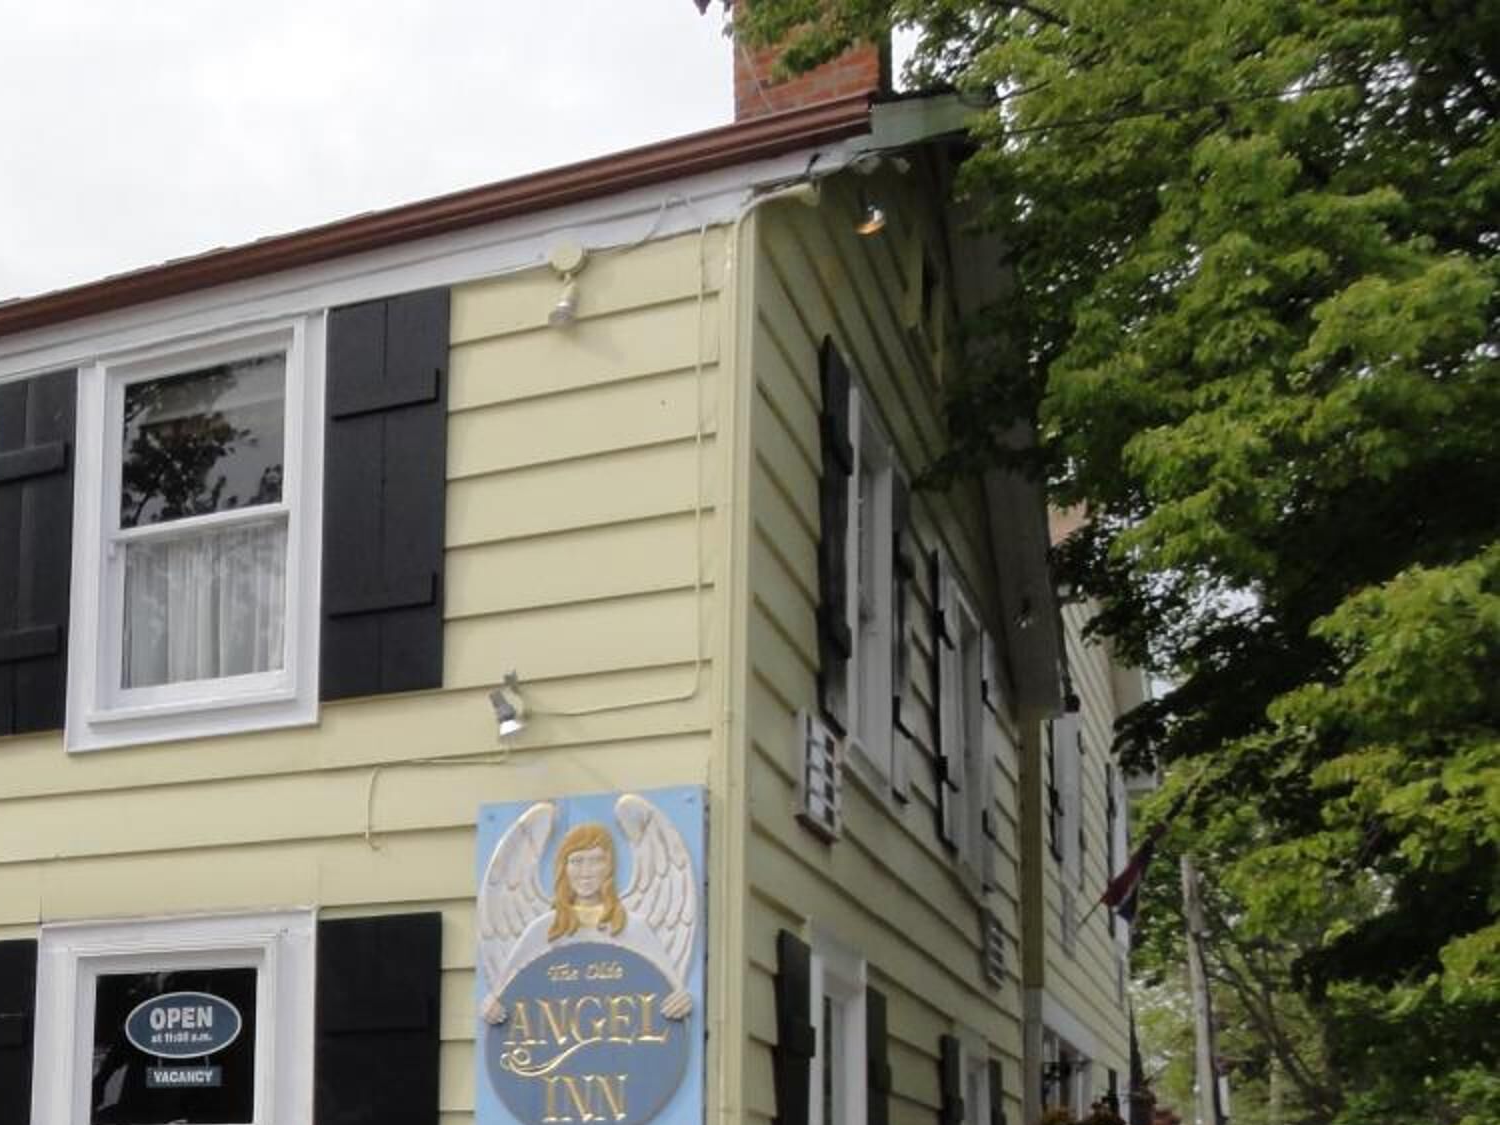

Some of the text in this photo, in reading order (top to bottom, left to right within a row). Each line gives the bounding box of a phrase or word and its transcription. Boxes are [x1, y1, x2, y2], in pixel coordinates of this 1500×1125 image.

[149, 1005, 213, 1031] OPEN
[502, 993, 670, 1047] ANGEL
[153, 1070, 213, 1083] VACANCY
[541, 1073, 629, 1123] INN
